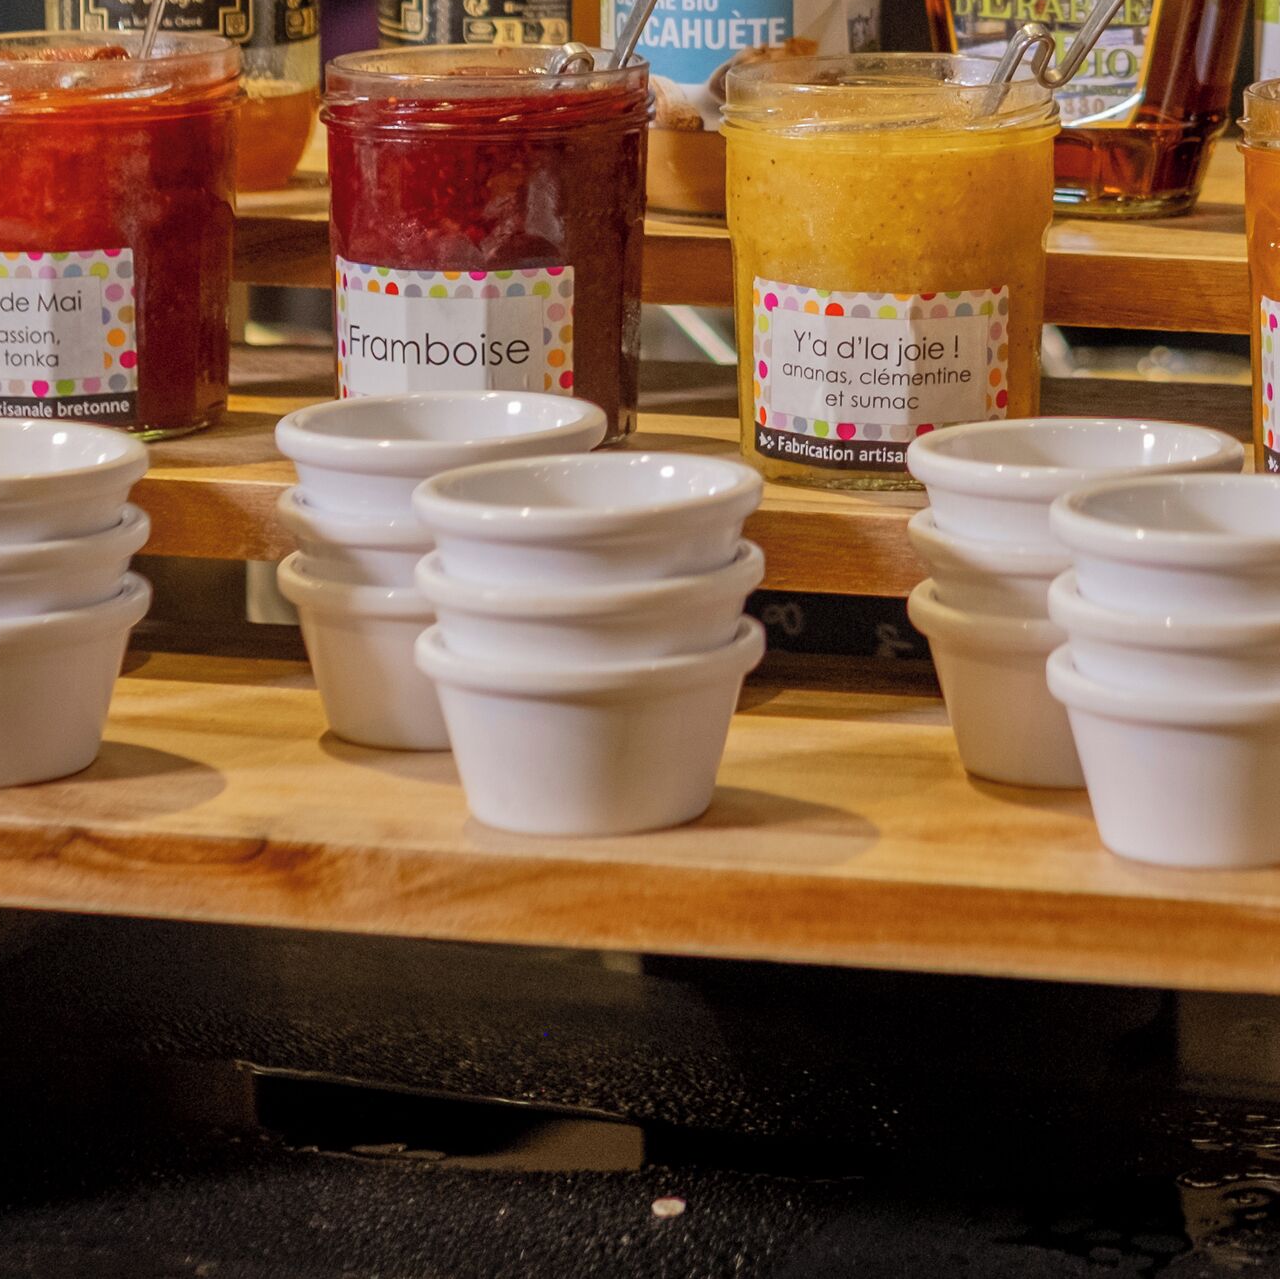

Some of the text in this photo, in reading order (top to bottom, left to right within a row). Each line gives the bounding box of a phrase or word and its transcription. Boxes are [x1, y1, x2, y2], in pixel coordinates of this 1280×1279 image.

[616, 9, 786, 50] CCAHUÈTE
[0, 292, 30, 313] de
[37, 289, 83, 313] Mai
[349, 324, 530, 367] Framboise
[793, 329, 827, 357] Y'a
[896, 335, 945, 367] joie
[953, 335, 959, 359] !
[4, 349, 60, 369] tonka
[782, 361, 972, 387] ananas, clémentine
[57, 399, 130, 417] bretonne
[824, 391, 920, 411] et sumac
[777, 435, 908, 464] Fabrication artisa
